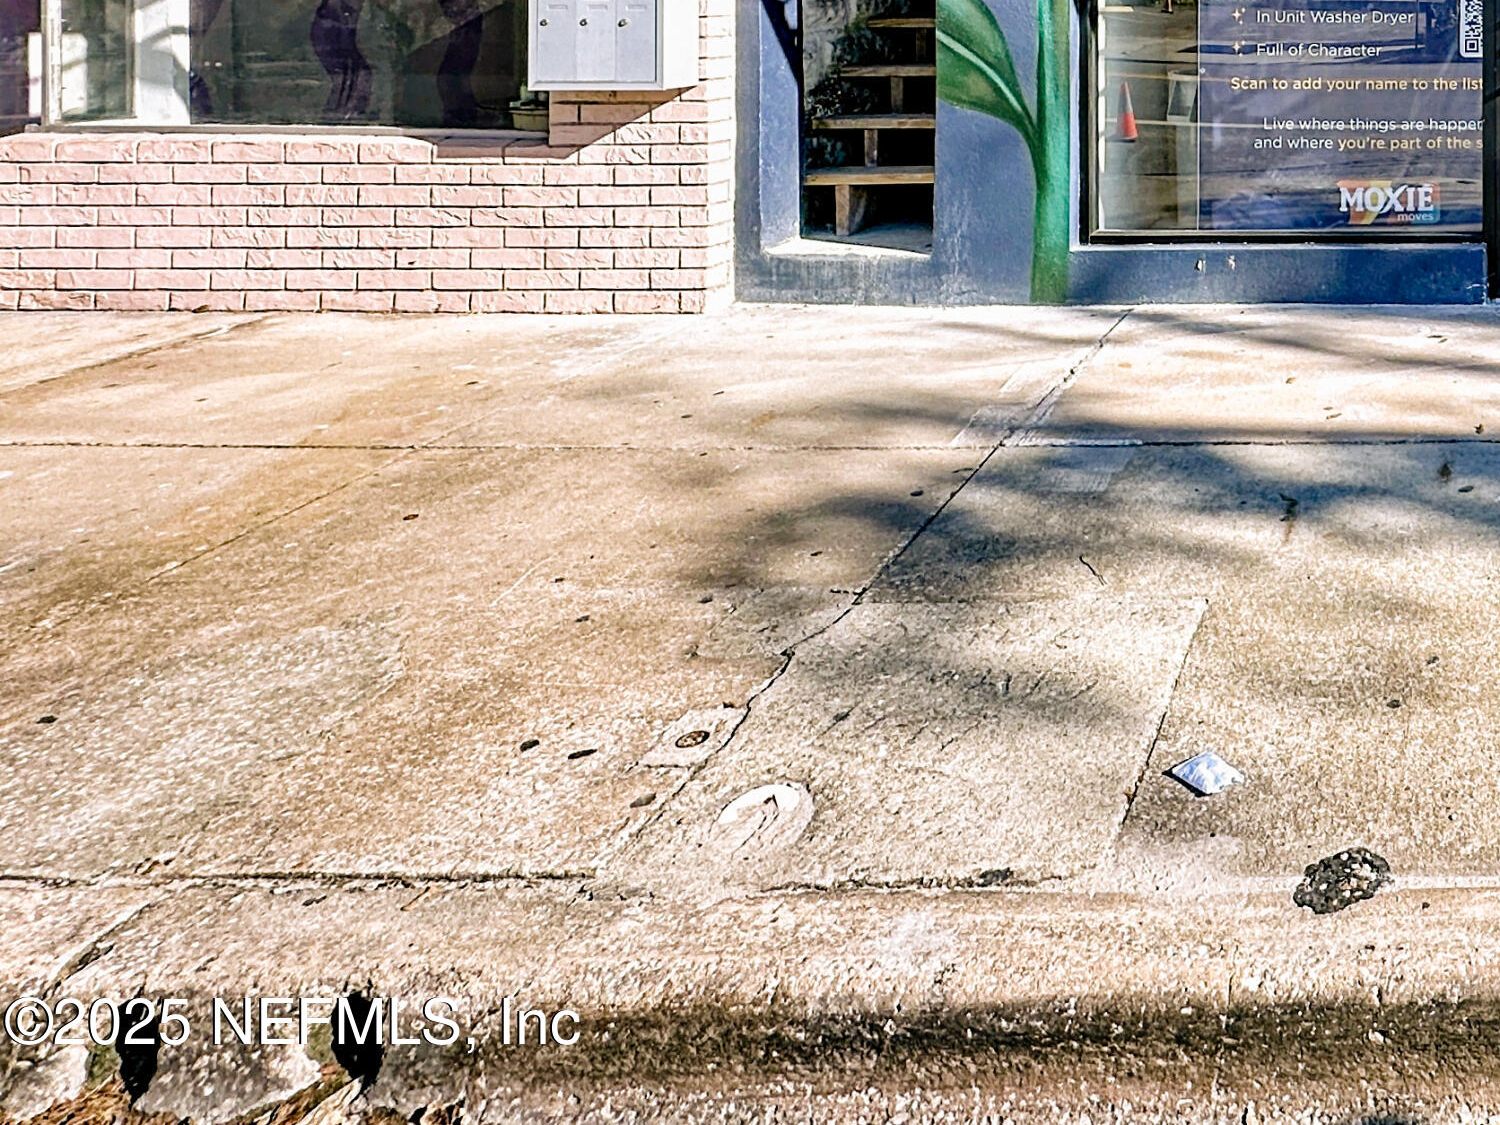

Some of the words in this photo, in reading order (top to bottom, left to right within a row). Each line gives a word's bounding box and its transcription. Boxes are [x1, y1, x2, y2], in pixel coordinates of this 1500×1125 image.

[1257, 11, 1270, 24] In
[1275, 11, 1305, 24] Unit
[1310, 11, 1367, 24] Washer
[1372, 11, 1414, 27] Dryer
[1257, 43, 1284, 56] Full
[1289, 43, 1304, 56] of
[1308, 43, 1382, 57] Character
[1231, 78, 1267, 90] Scan
[1272, 78, 1288, 90] to
[1293, 77, 1322, 90] add
[1327, 80, 1360, 92] your
[1366, 80, 1408, 90] name
[1413, 78, 1428, 90] to
[1433, 77, 1457, 90] the
[1263, 118, 1293, 131] Live
[1299, 118, 1345, 131] where
[1350, 117, 1396, 133] things
[1401, 120, 1424, 131] are
[1254, 136, 1282, 149] and
[1288, 136, 1333, 149] where
[1338, 136, 1385, 151] you're
[1390, 138, 1421, 152] part
[1427, 136, 1442, 149] of
[1447, 136, 1471, 149] the
[1339, 184, 1434, 213] MOXIE
